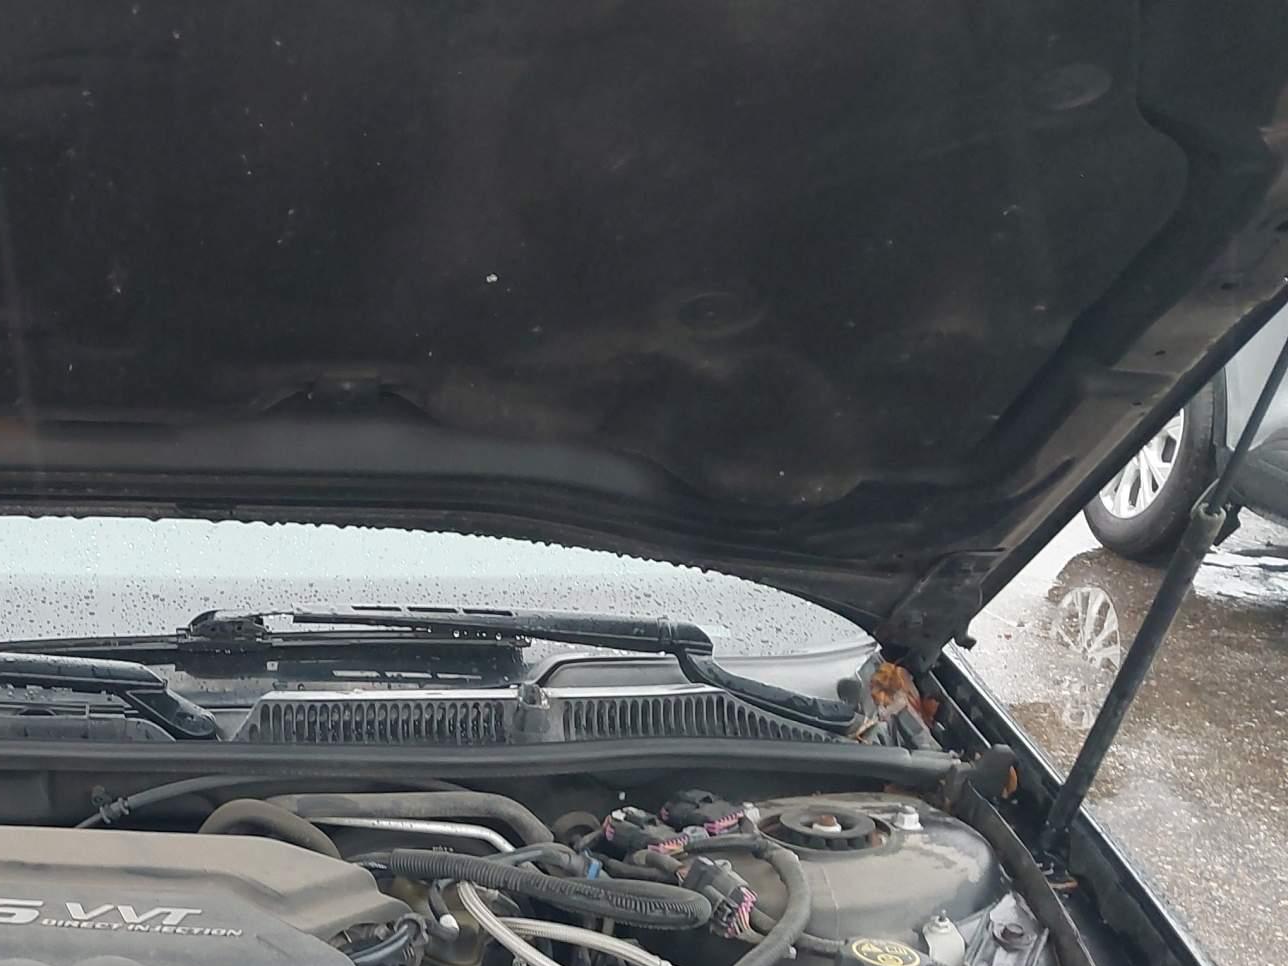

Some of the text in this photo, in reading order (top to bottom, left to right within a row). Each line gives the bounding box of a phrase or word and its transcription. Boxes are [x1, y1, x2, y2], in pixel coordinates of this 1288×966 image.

[65, 902, 202, 926] VVT
[41, 918, 243, 937] DIRECT INJECTION
